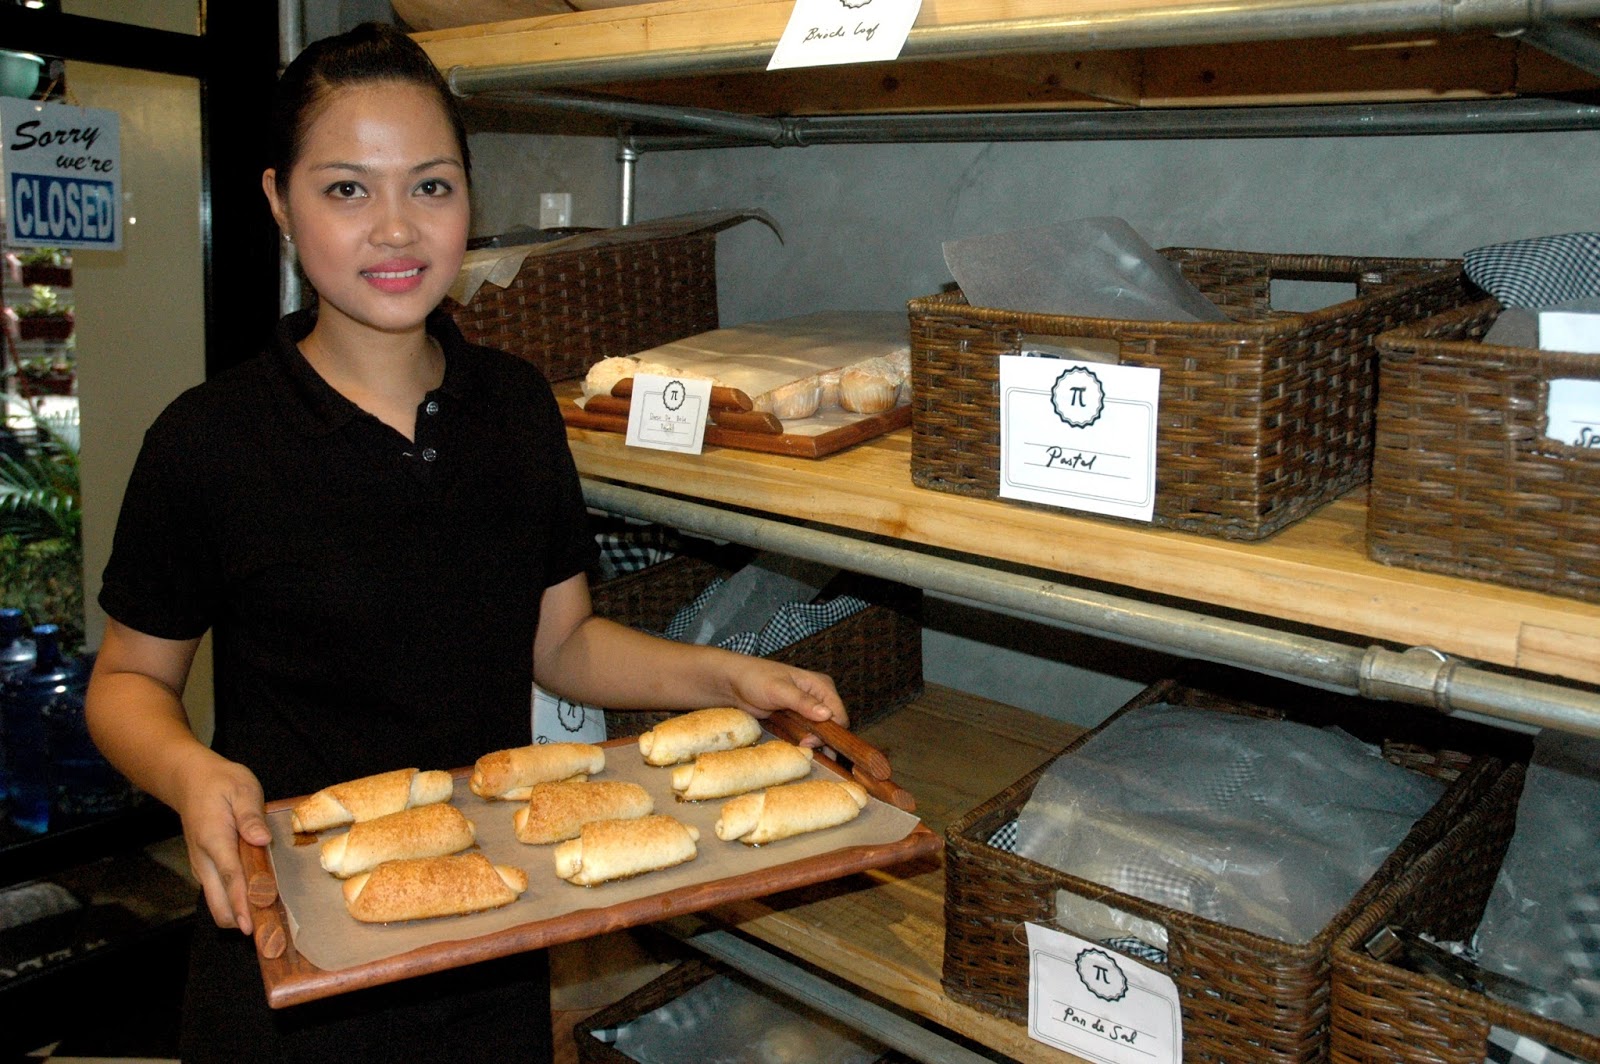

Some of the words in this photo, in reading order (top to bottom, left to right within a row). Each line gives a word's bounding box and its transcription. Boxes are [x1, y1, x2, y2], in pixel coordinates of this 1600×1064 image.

[10, 120, 100, 150] Sorry
[56, 154, 113, 173] we're
[14, 177, 113, 239] CLOSED
[1046, 446, 1097, 470] Pastel
[1064, 1007, 1086, 1027] Pan
[1091, 1019, 1105, 1033] de
[1109, 1025, 1138, 1045] Sal
